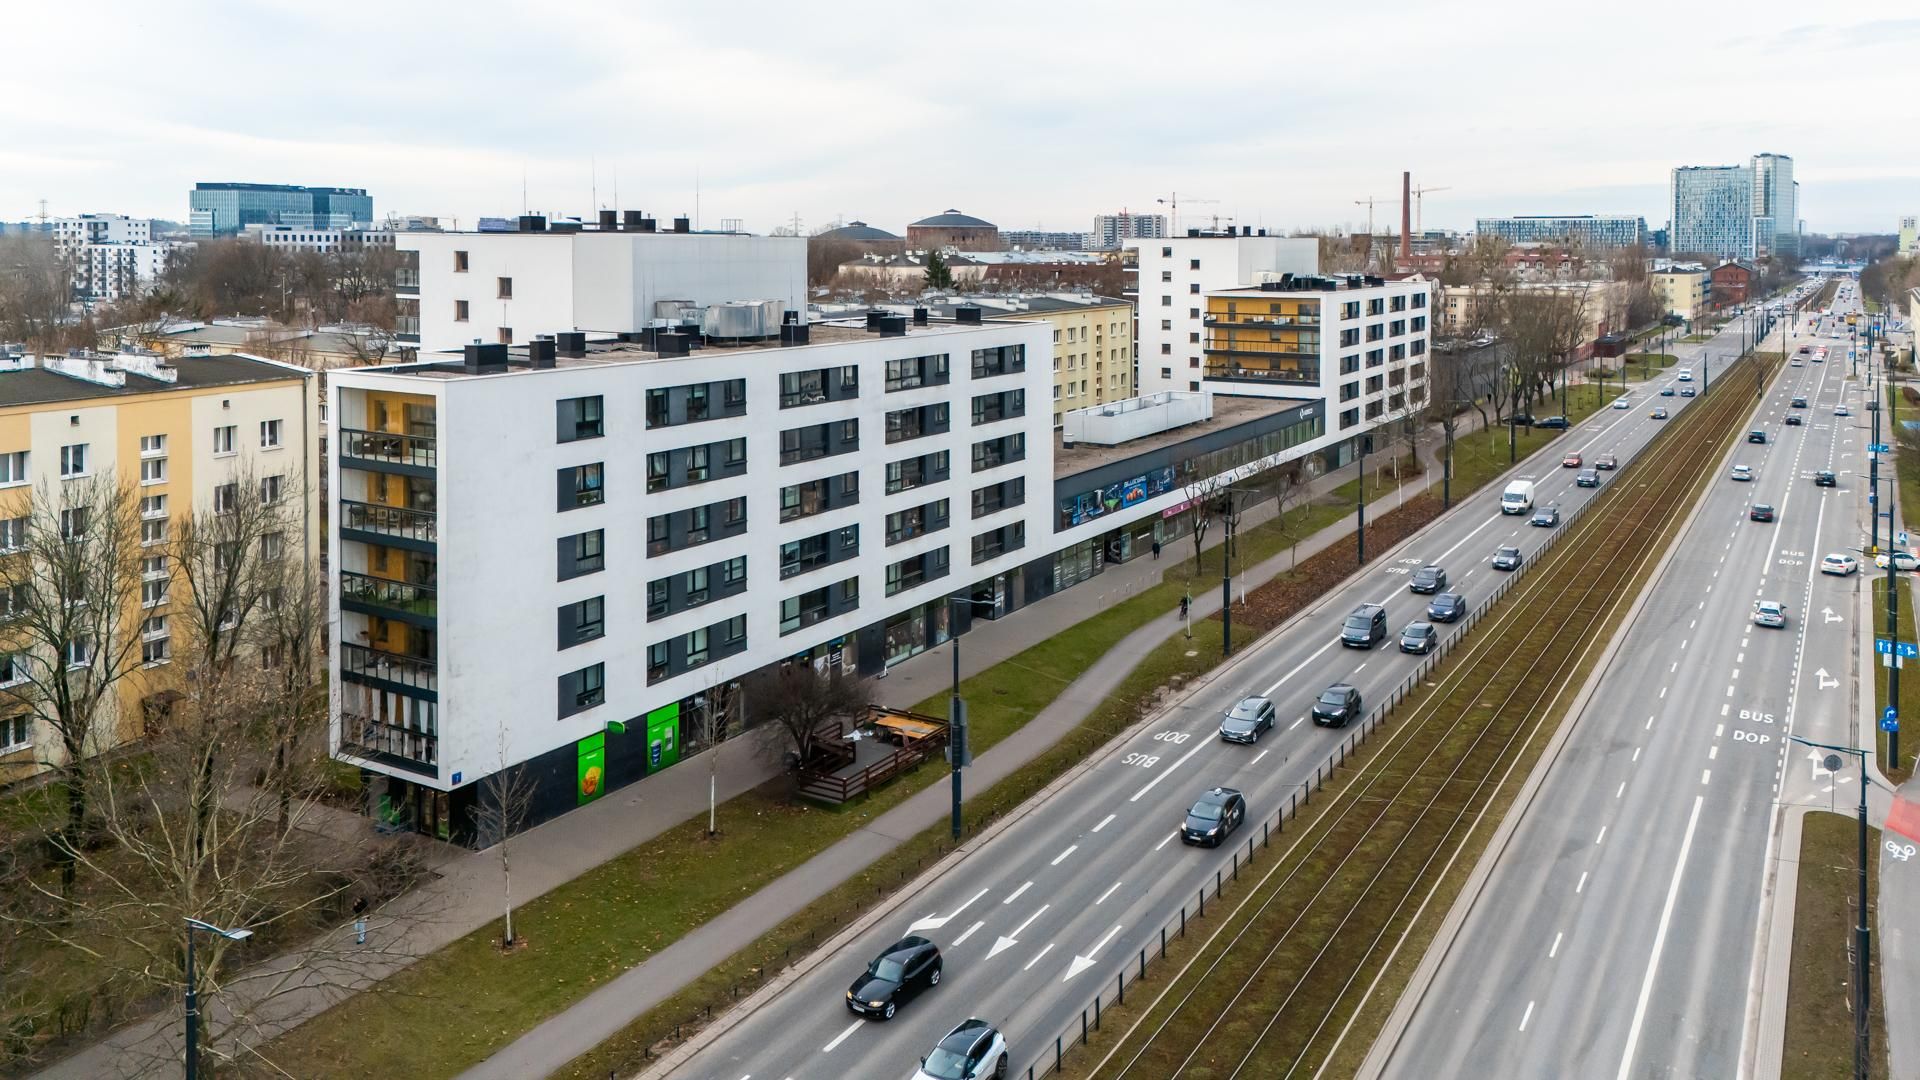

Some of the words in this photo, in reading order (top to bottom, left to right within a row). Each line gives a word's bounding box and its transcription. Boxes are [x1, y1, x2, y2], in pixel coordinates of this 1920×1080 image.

[1385, 567, 1410, 575] BUS
[1739, 709, 1774, 724] BUS
[1153, 730, 1191, 744] DOP
[1733, 730, 1770, 745] DOP
[1122, 752, 1160, 768] BUS
